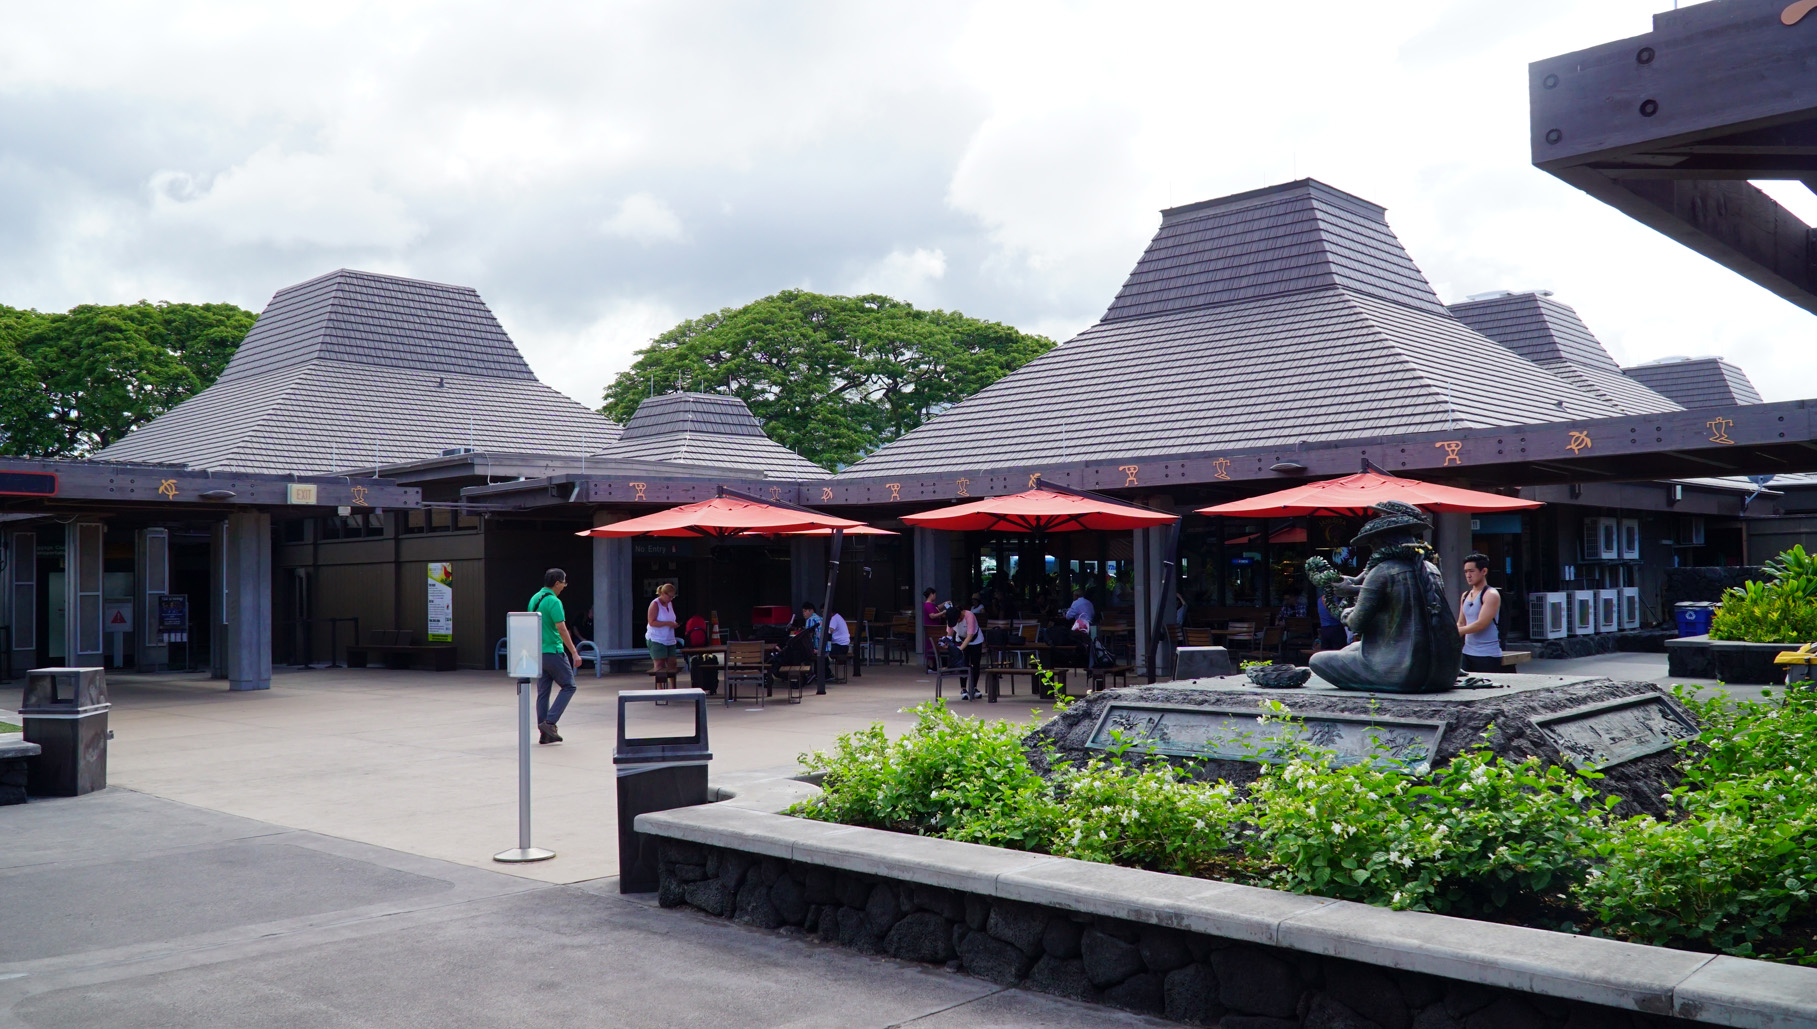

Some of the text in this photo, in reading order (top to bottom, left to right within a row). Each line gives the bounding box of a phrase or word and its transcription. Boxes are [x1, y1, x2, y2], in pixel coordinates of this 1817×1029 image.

[296, 488, 312, 500] EXIT
[635, 544, 666, 554] No Entry
